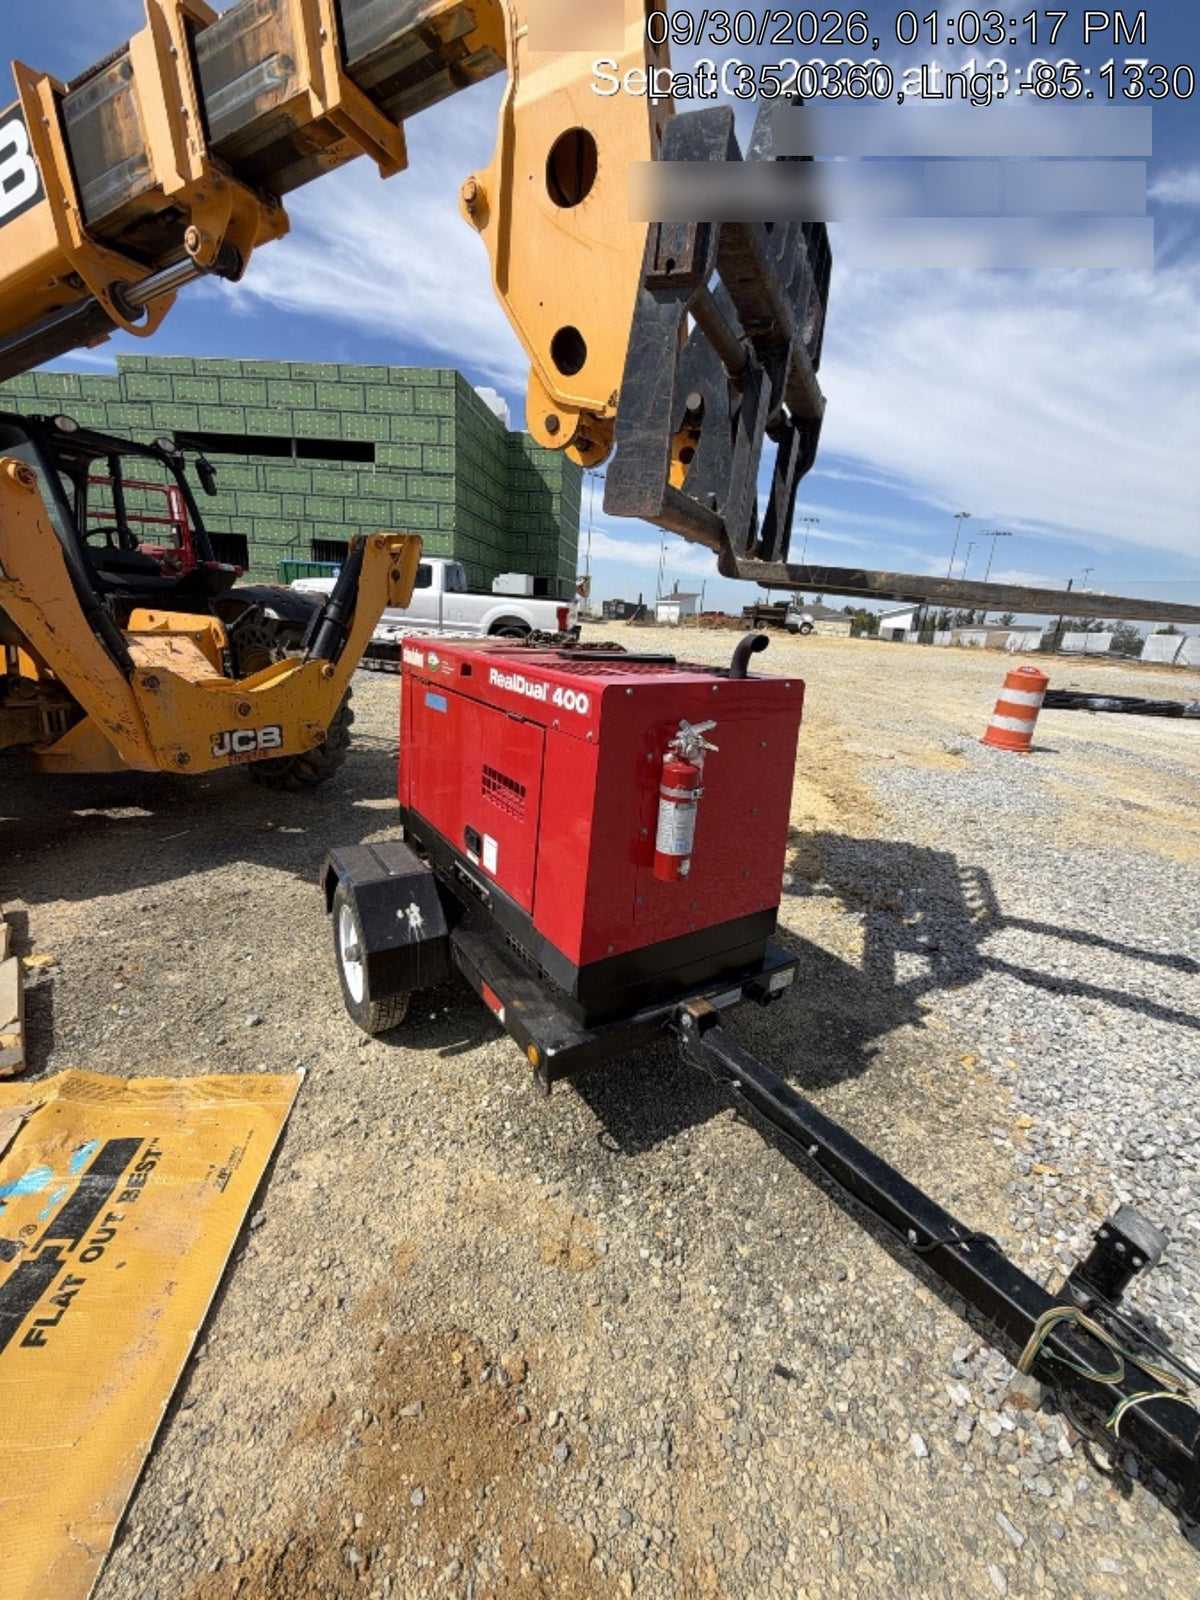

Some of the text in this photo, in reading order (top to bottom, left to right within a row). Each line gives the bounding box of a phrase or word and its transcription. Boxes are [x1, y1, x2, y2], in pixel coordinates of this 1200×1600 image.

[489, 668, 590, 714] RealDual 400
[210, 726, 283, 758] JCB
[20, 1274, 87, 1348] FLAT
[79, 1211, 125, 1263] OUT
